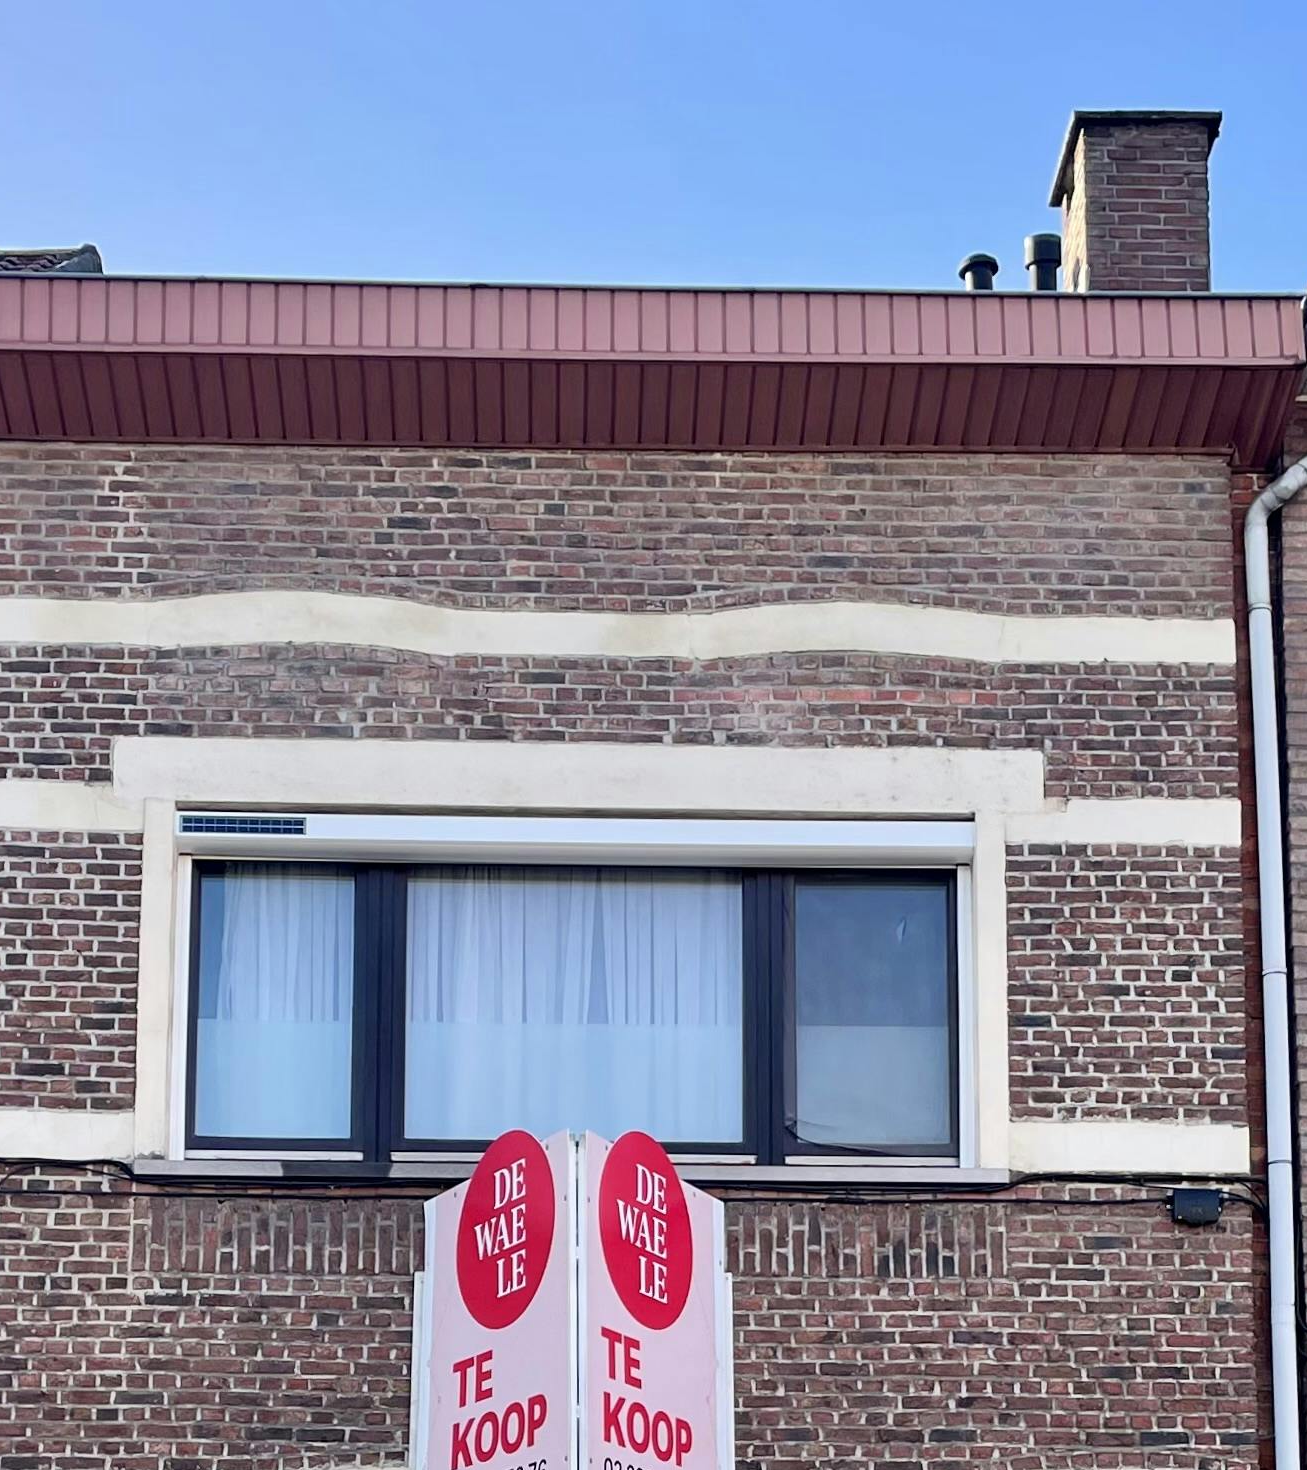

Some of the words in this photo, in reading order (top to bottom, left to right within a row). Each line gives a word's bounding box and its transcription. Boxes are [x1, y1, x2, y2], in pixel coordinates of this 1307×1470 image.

[493, 1157, 527, 1210] DE
[636, 1162, 667, 1215] DE
[473, 1203, 527, 1261] WAE
[616, 1198, 667, 1260] WAE
[496, 1248, 527, 1299] LE
[638, 1255, 668, 1305] LE
[452, 1349, 494, 1409] TE
[600, 1325, 643, 1390] TE
[603, 1391, 693, 1468] KOOP
